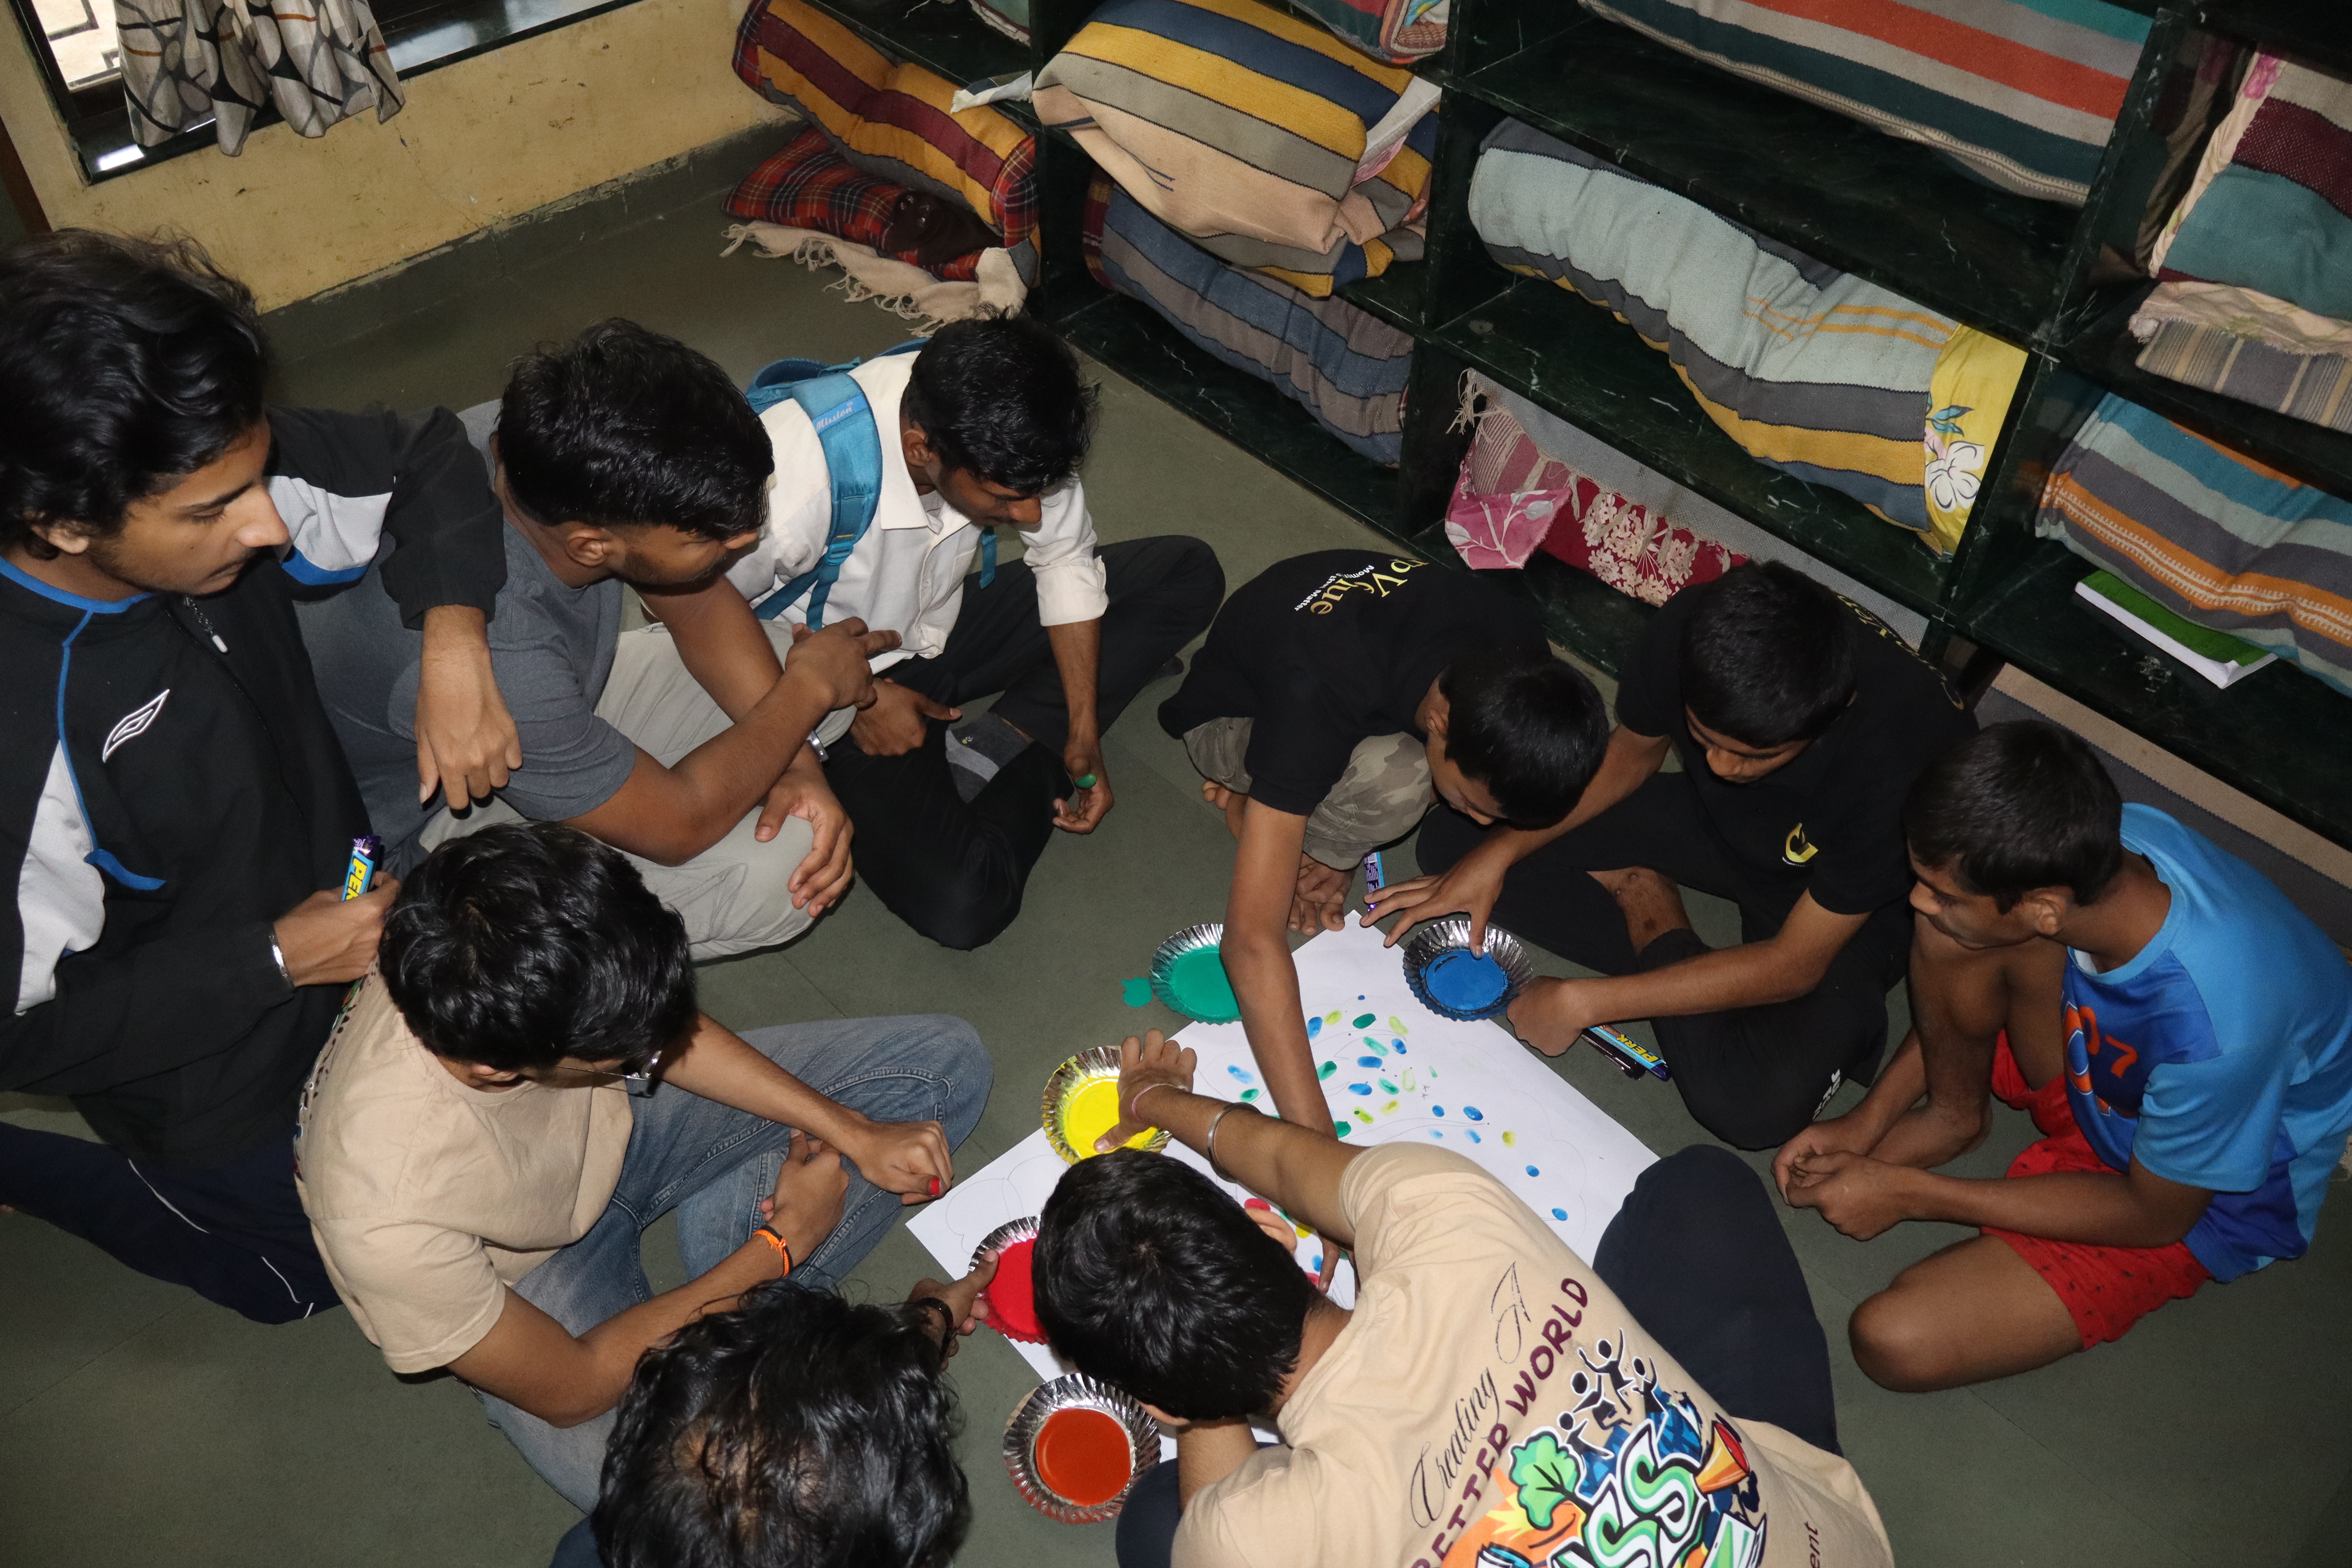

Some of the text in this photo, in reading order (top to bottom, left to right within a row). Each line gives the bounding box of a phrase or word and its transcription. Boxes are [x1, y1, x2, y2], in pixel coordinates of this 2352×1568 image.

[1294, 590, 1321, 611] Matter
[1616, 1034, 1659, 1063] PERK
[1505, 1278, 1588, 1417] WORLD
[1410, 1261, 1531, 1528] Creating A
